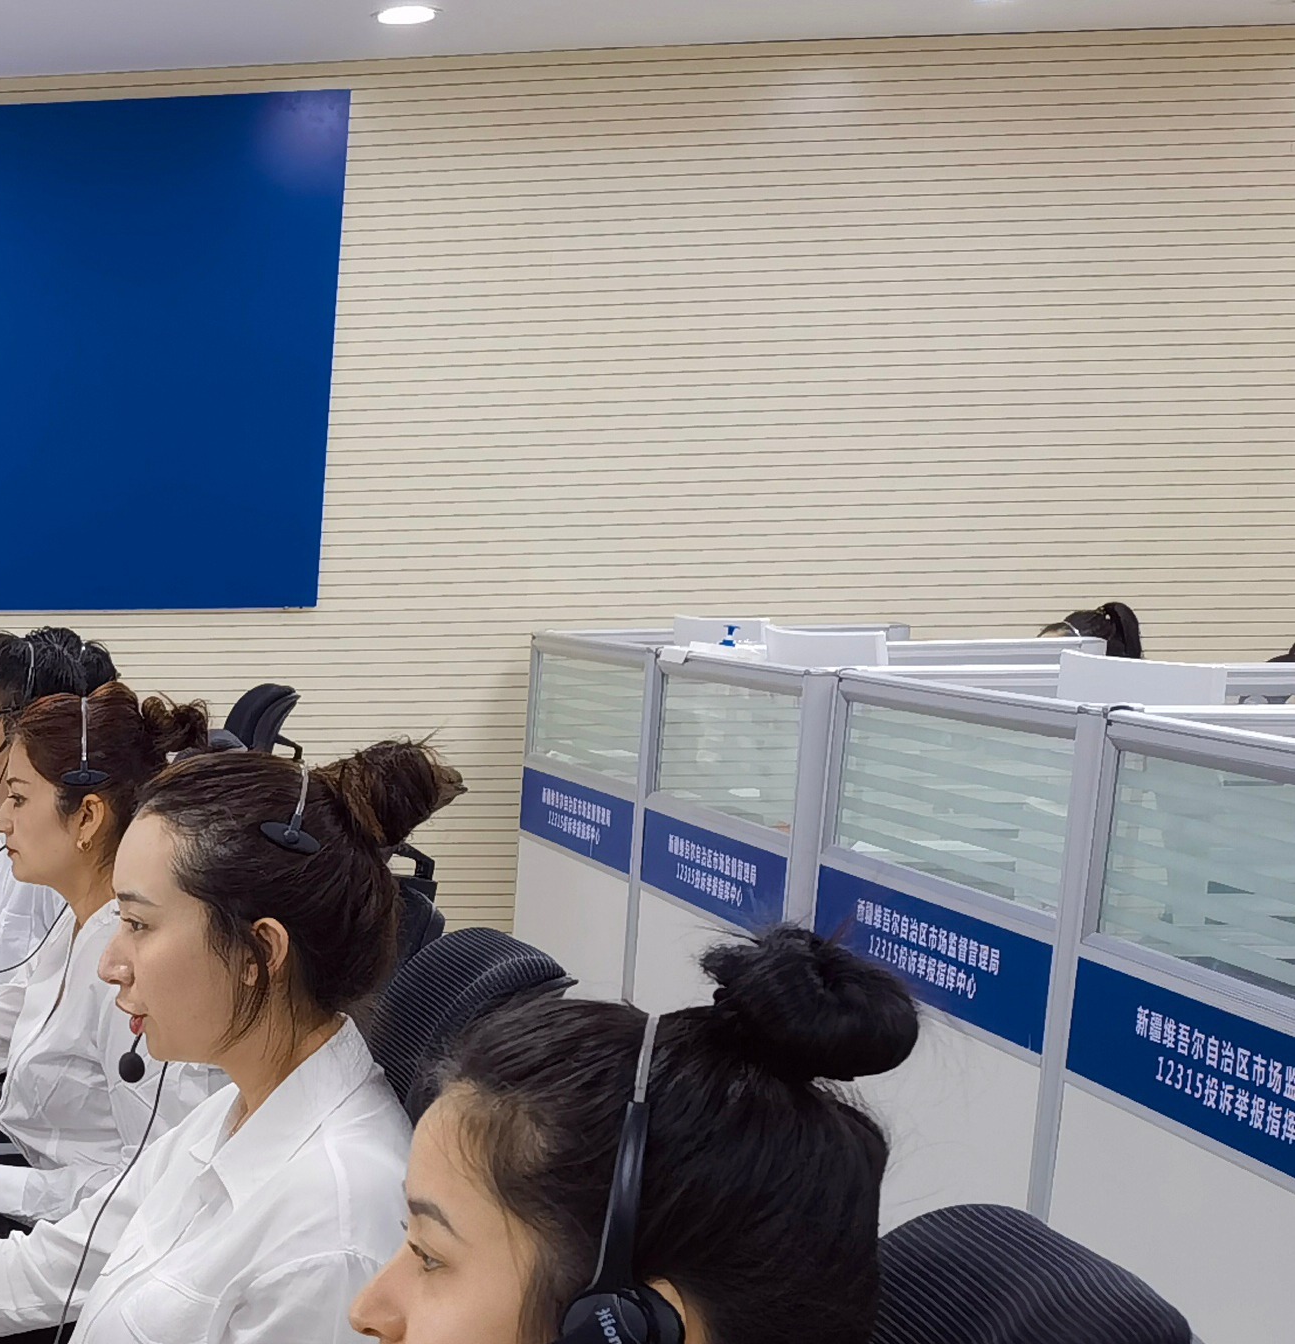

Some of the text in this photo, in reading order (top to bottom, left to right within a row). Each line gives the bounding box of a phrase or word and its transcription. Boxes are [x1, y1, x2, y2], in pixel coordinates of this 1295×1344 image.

[856, 898, 1001, 976] 新疆维吾尔自治区市场监督管理局
[868, 934, 978, 1000] 12315投诉举报指挥中心
